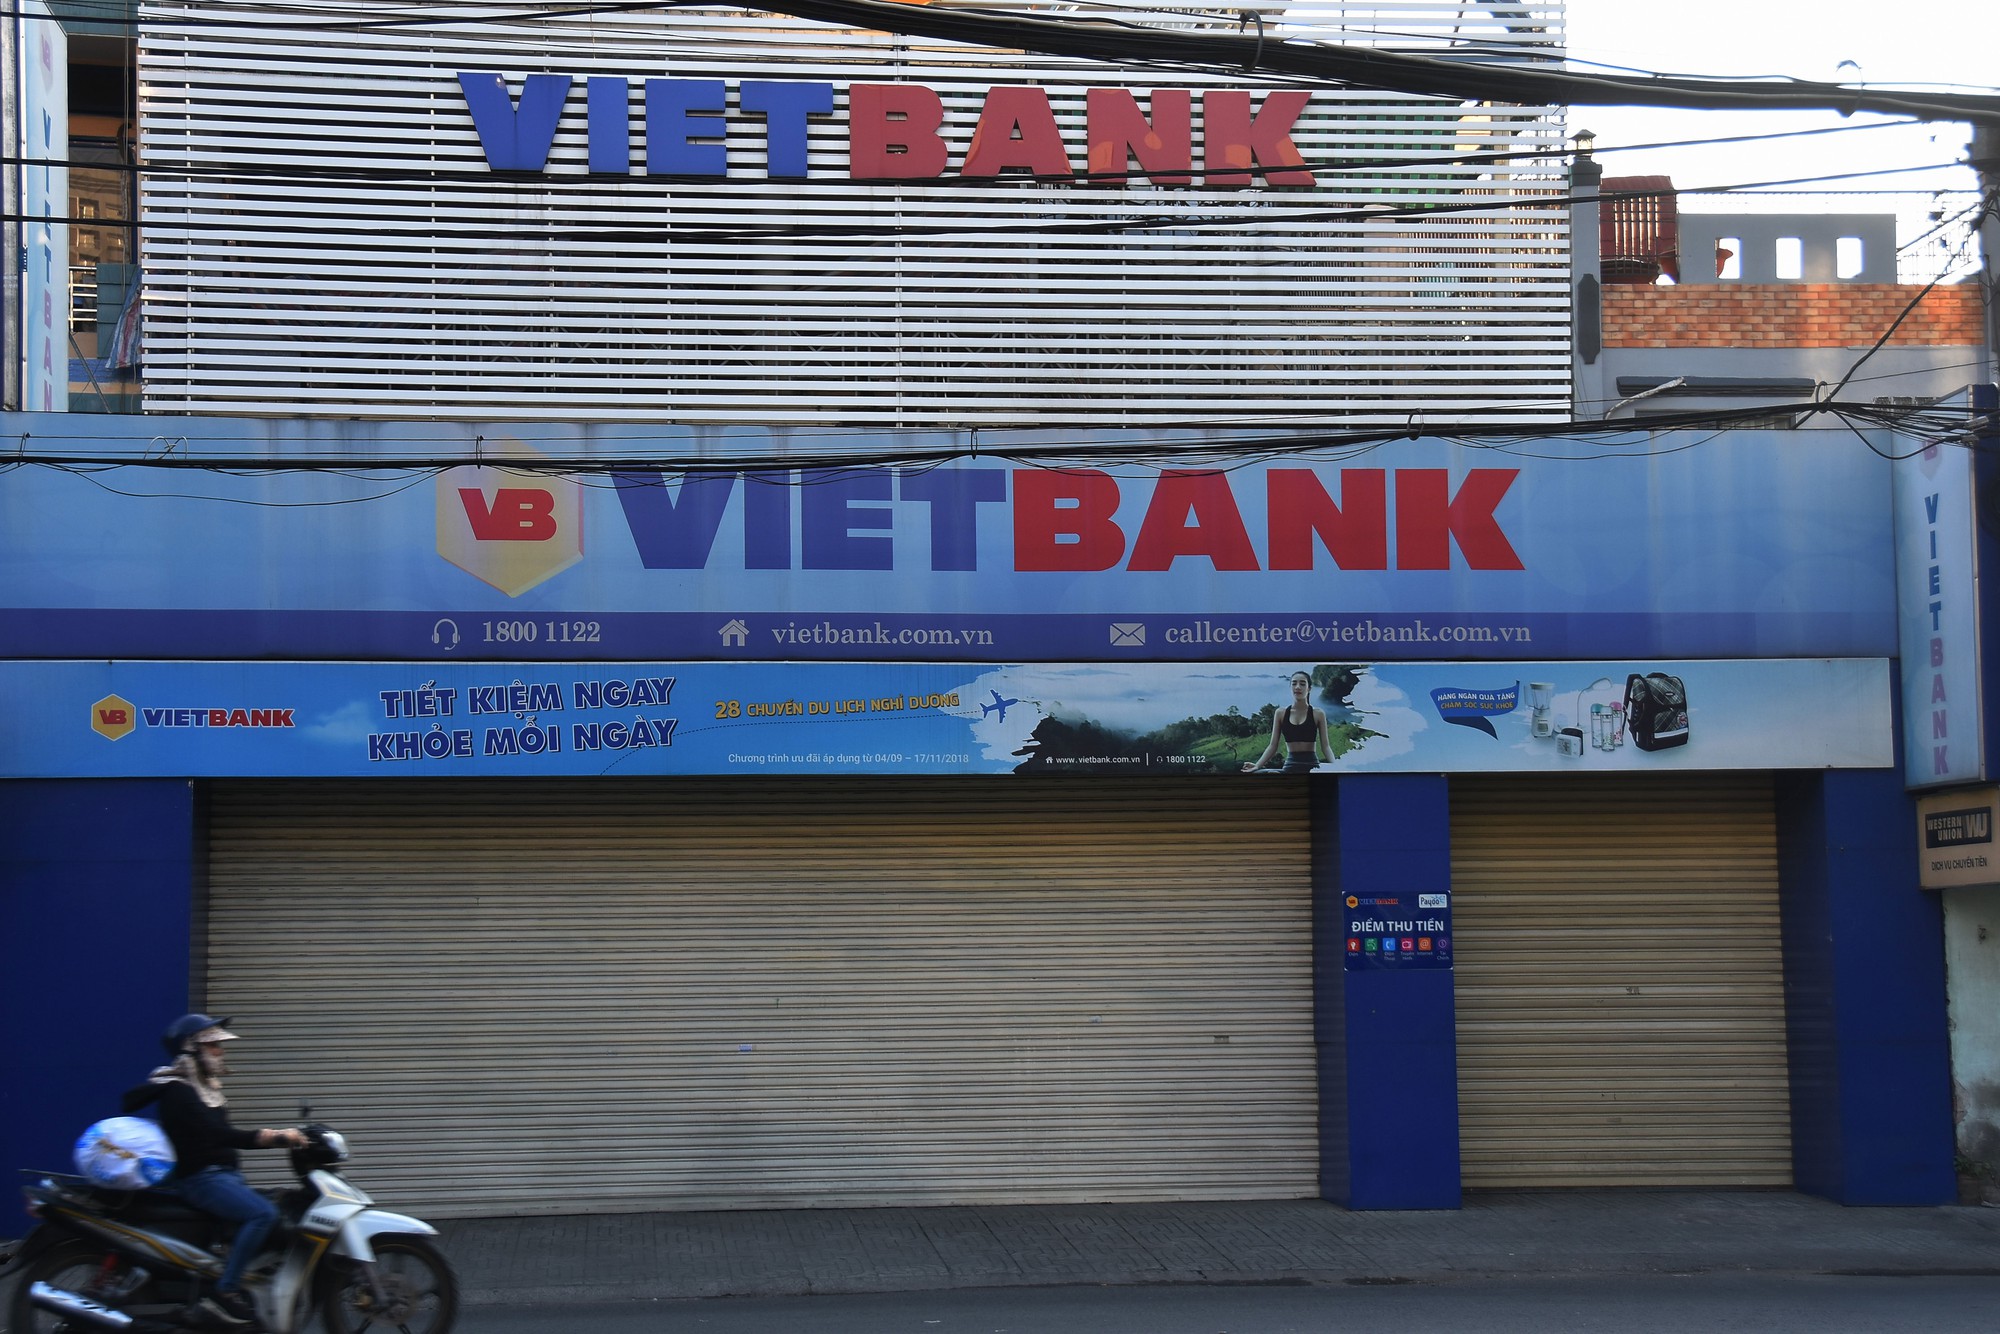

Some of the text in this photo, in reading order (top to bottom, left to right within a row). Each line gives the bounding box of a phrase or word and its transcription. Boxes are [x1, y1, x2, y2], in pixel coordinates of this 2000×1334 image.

[456, 71, 1318, 187] VIETBANK
[458, 488, 557, 541] VB
[610, 467, 1526, 572] VIETBANK
[483, 621, 601, 642] 1800 1122
[772, 621, 994, 646] vietbank.com.vn
[1165, 620, 1532, 644] callcenter@vietbank.com.vn
[1924, 493, 1949, 775] VIETBANK
[379, 677, 675, 720] TIẾT KIỆM NGAY
[99, 709, 127, 725] VB
[142, 708, 295, 728] VIETBANK
[715, 700, 741, 719] 28
[808, 701, 830, 715] DU
[835, 700, 865, 717] LỊCH
[368, 715, 678, 761] KHỎE MỖI NGÀY
[823, 753, 835, 766] áp
[875, 753, 903, 764] 04/09
[914, 753, 969, 764] 17/11/2018
[1055, 755, 1140, 765] www.vietbank.com.vn
[1166, 755, 1206, 764] 1800 1122
[1927, 816, 1962, 830] WESTERN
[1937, 828, 1963, 841] UNION
[1421, 897, 1440, 907] Payoo
[1387, 921, 1413, 932] THU
